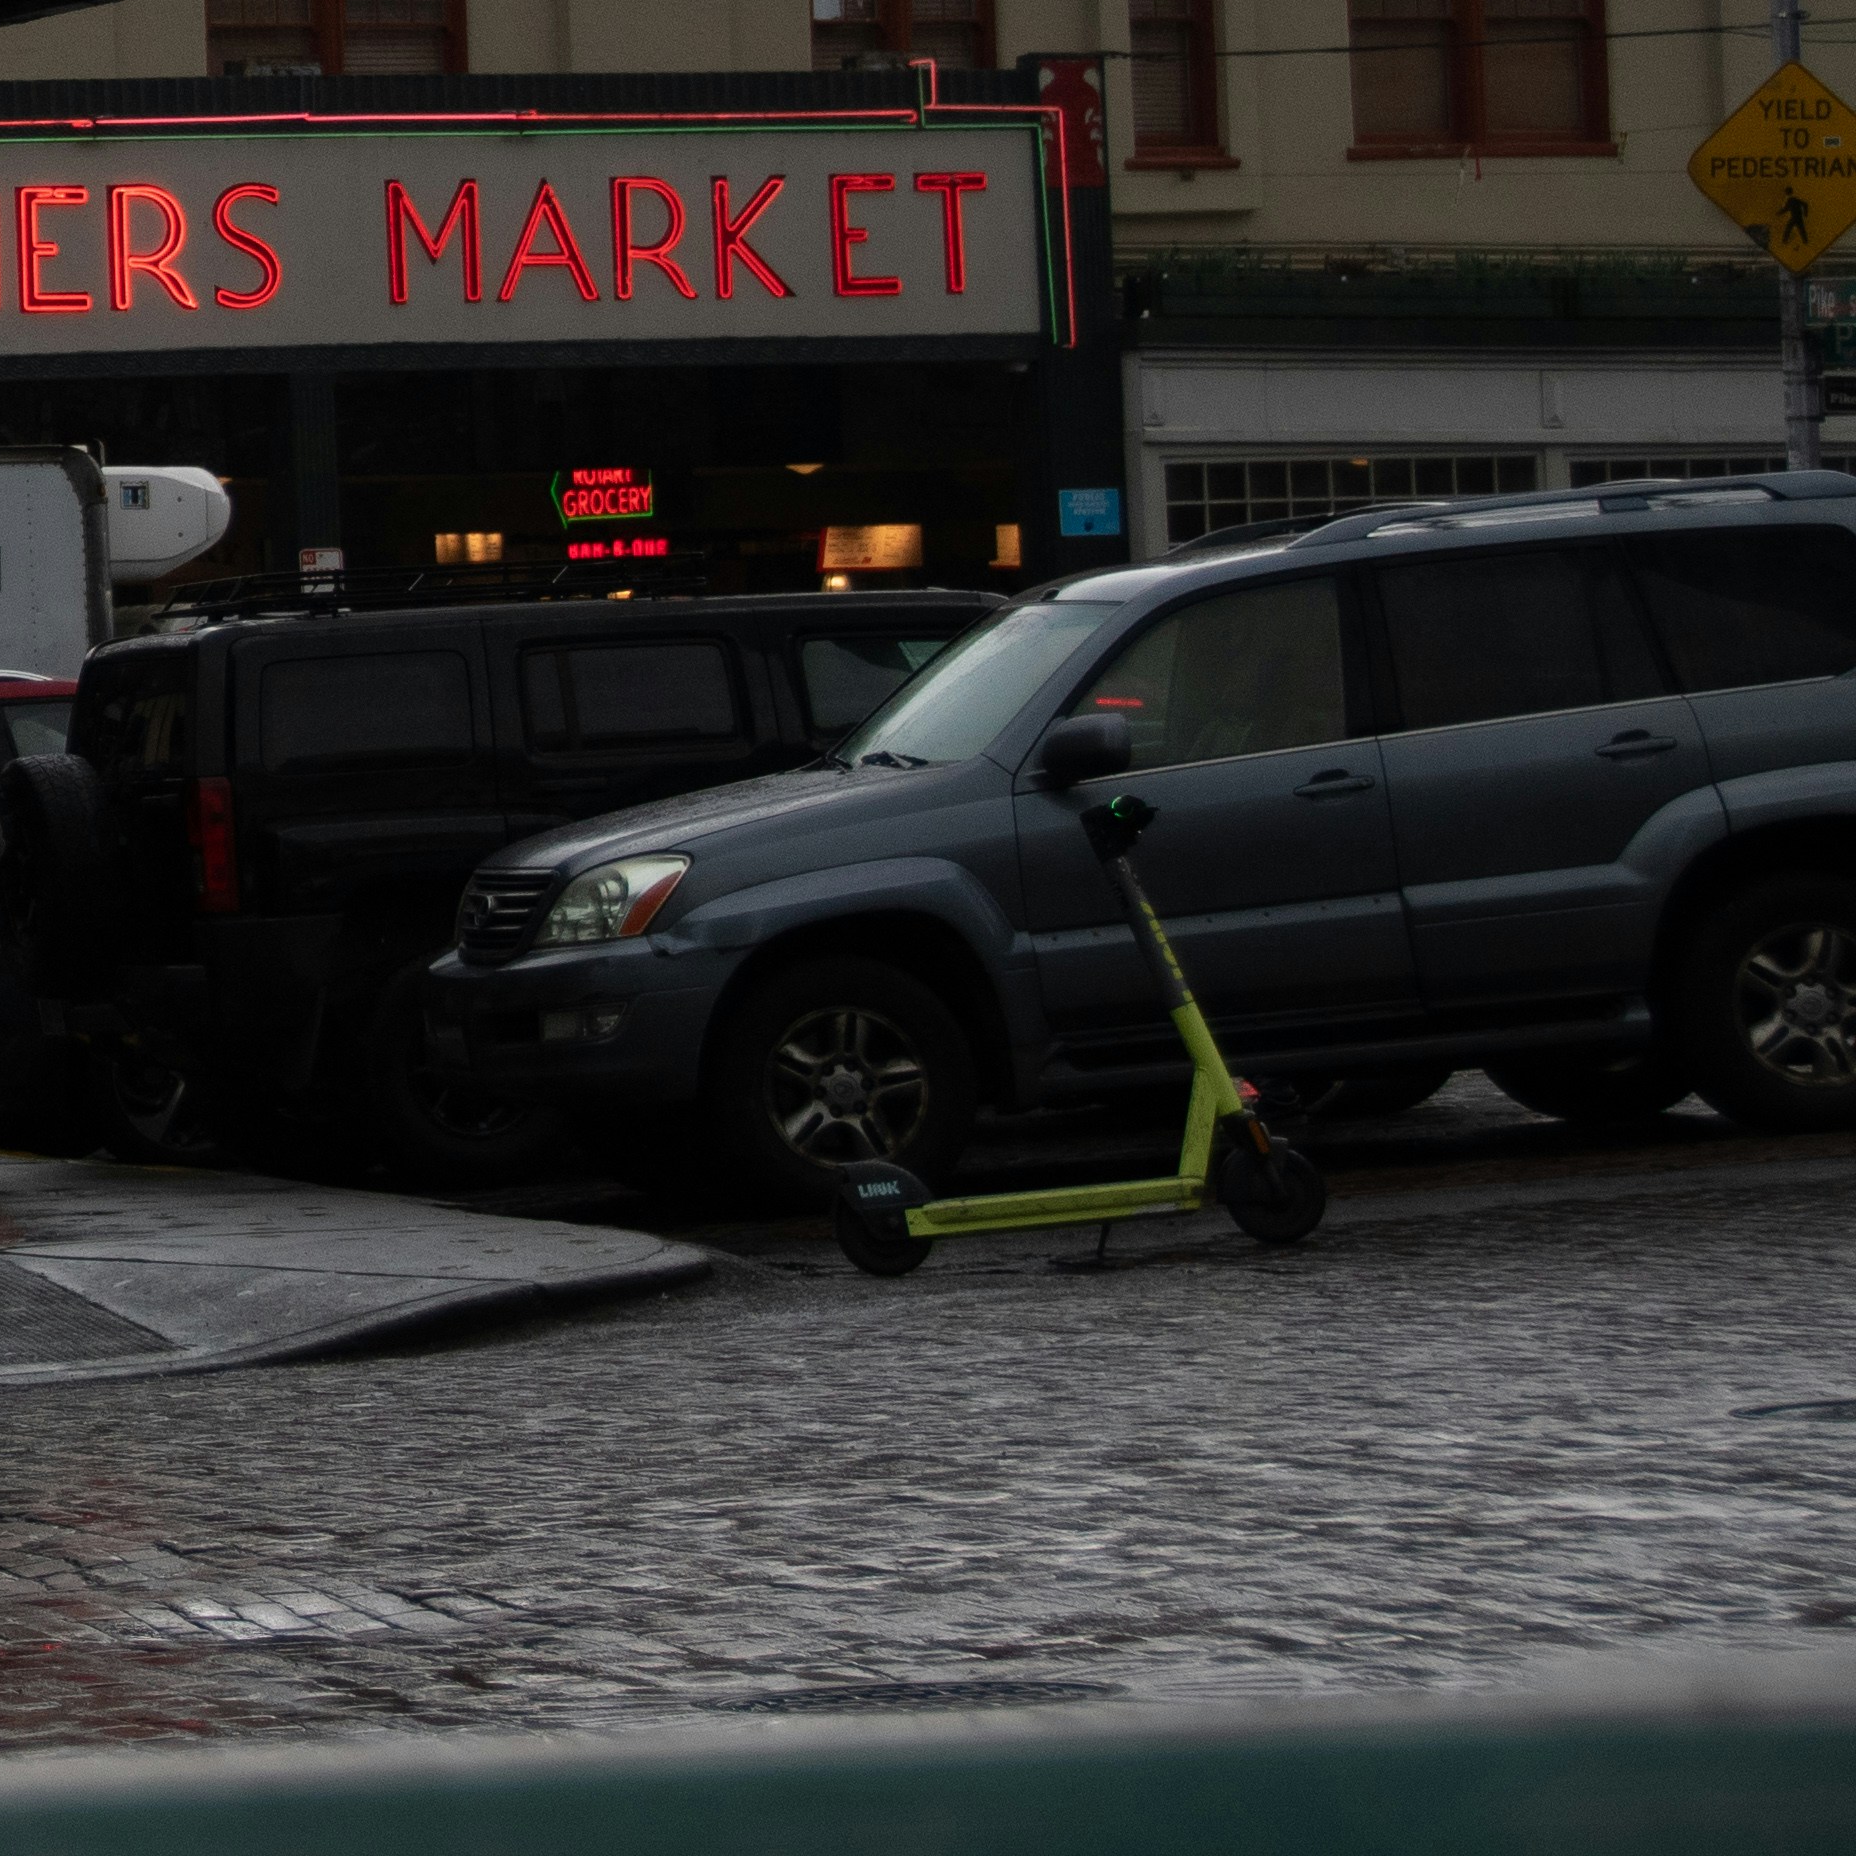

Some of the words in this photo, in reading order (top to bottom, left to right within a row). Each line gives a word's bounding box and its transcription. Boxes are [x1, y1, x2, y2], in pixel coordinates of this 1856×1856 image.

[1758, 99, 1832, 121] YIELD
[1779, 127, 1810, 150] TO
[385, 170, 987, 306] MARKET
[562, 484, 652, 517] GROCERY
[857, 1180, 901, 1199] LINK
